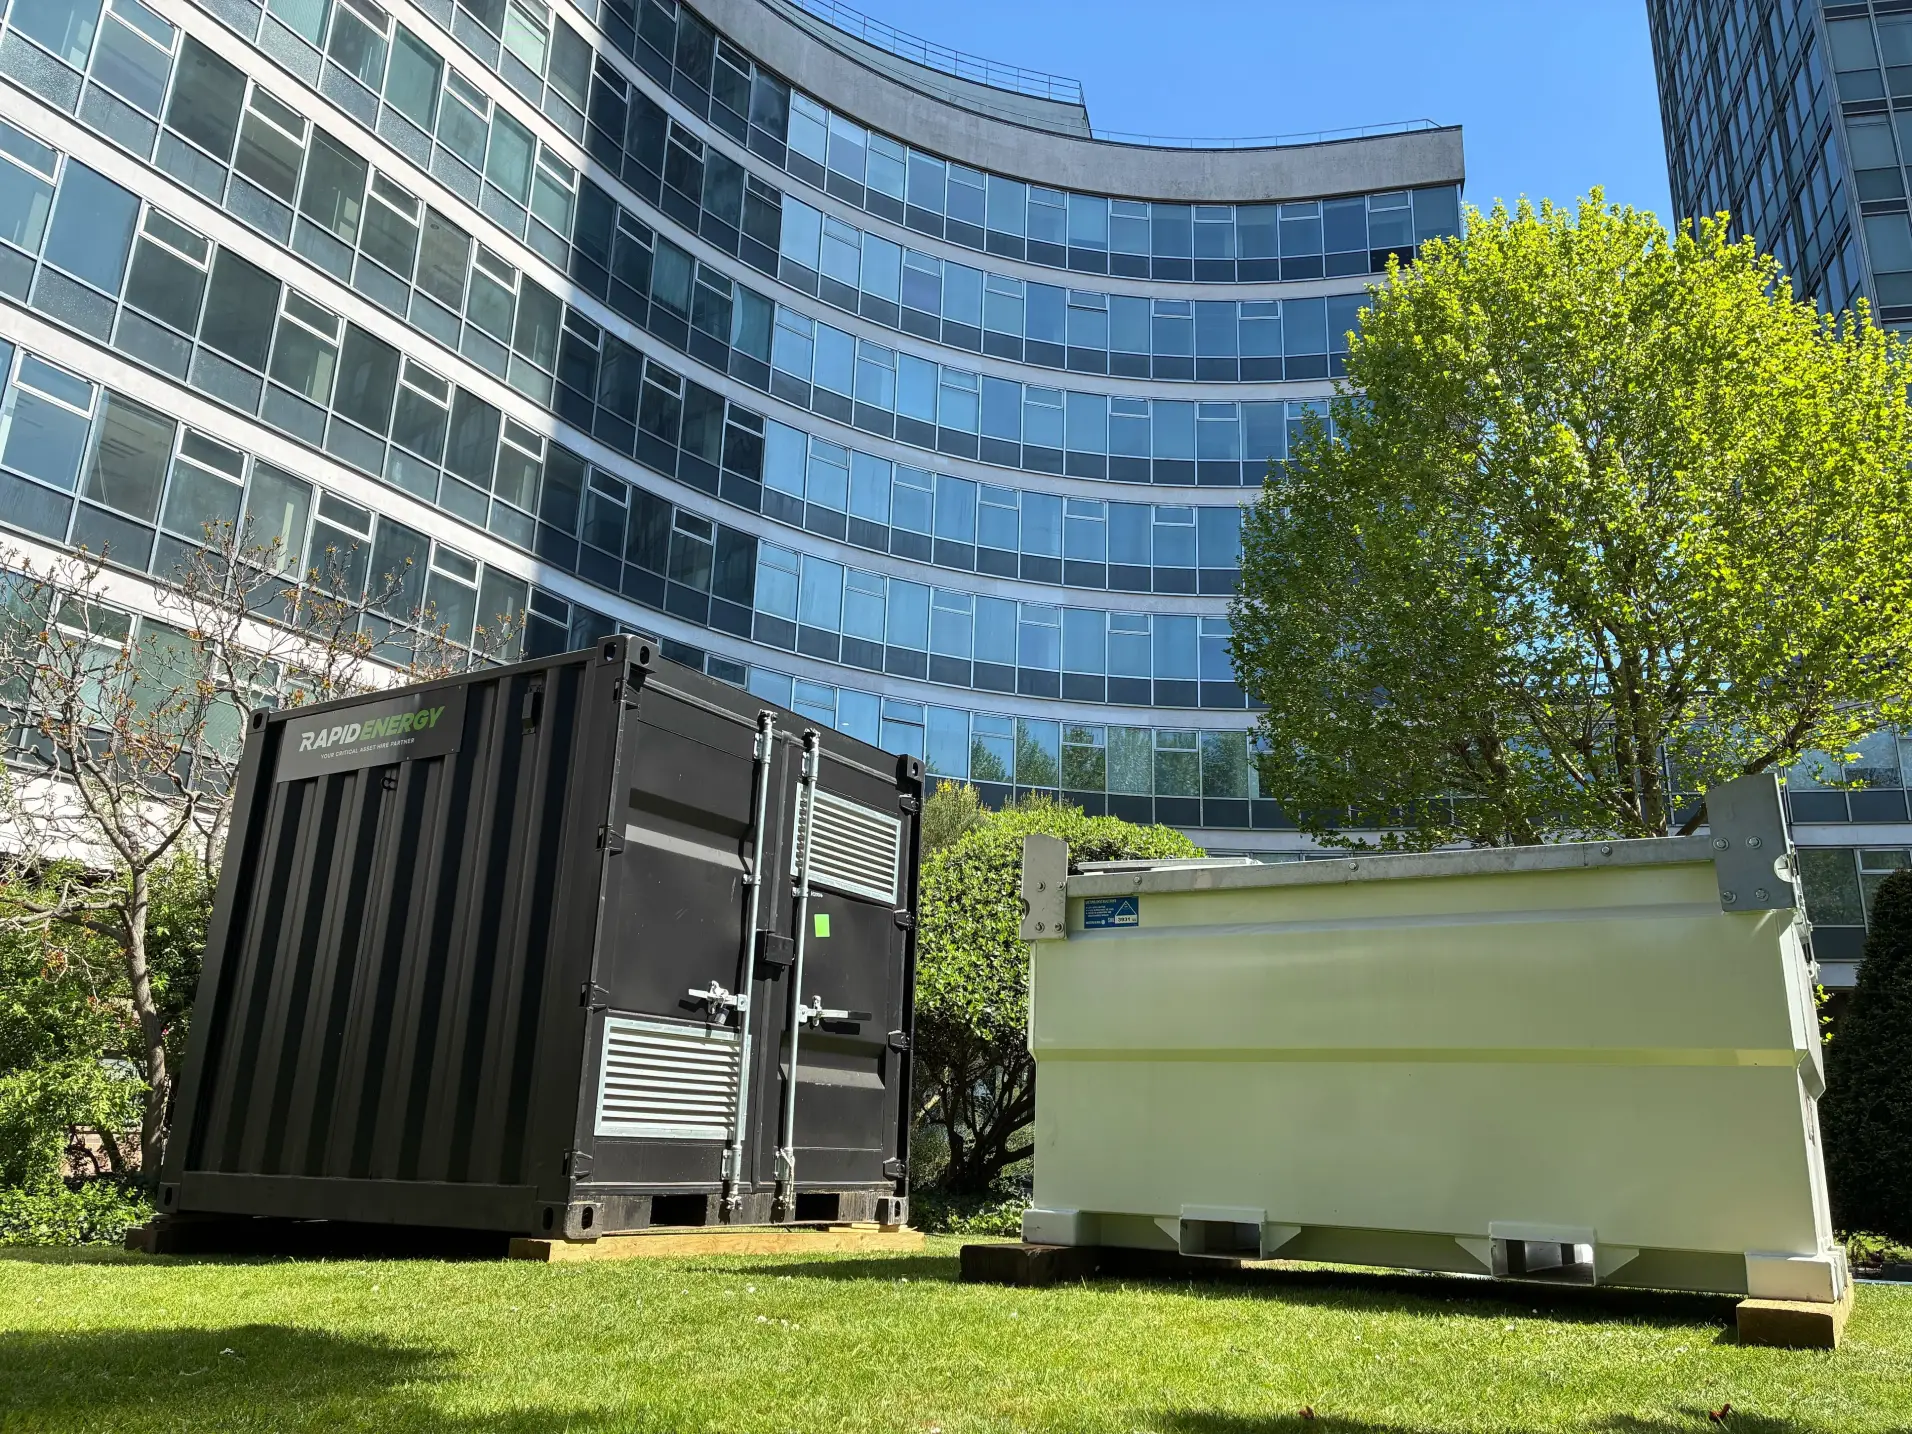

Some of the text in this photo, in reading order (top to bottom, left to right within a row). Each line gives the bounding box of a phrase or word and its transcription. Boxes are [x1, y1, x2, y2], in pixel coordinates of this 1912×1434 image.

[335, 749, 358, 757] CRITICAL
[359, 744, 377, 752] ASSET
[377, 741, 389, 749] HIRE
[390, 737, 415, 746] PARTNER
